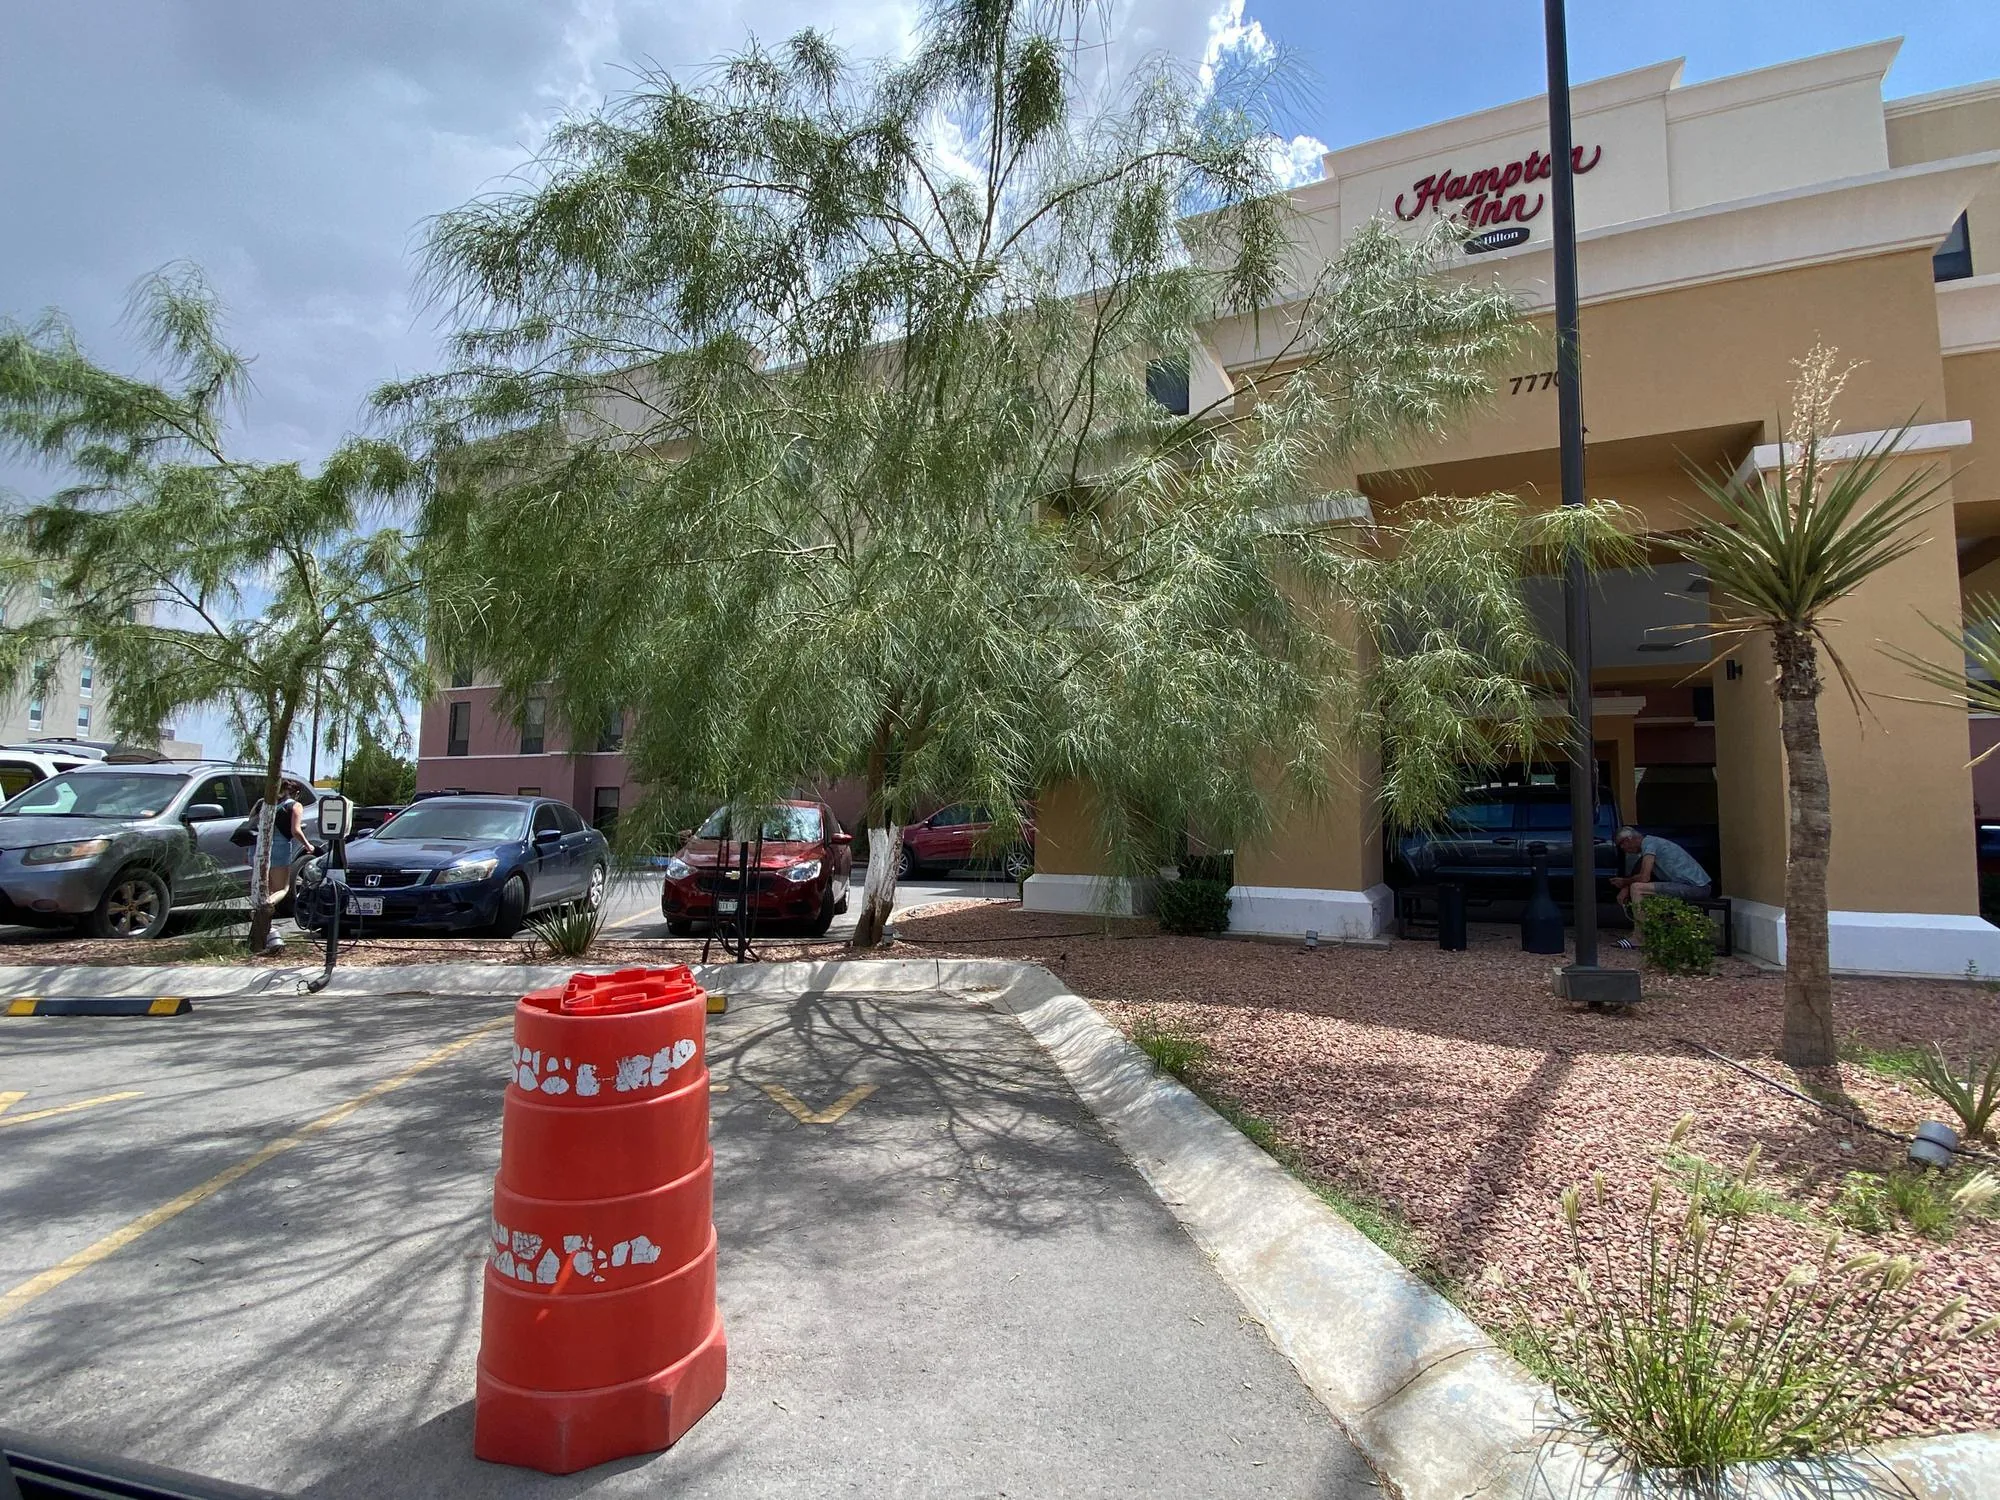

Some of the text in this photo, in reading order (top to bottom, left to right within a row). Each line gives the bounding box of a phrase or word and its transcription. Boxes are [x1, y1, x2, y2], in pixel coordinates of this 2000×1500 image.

[1395, 145, 1601, 221] Hampton
[1450, 193, 1543, 231] Inn
[1484, 231, 1519, 245] Hilton
